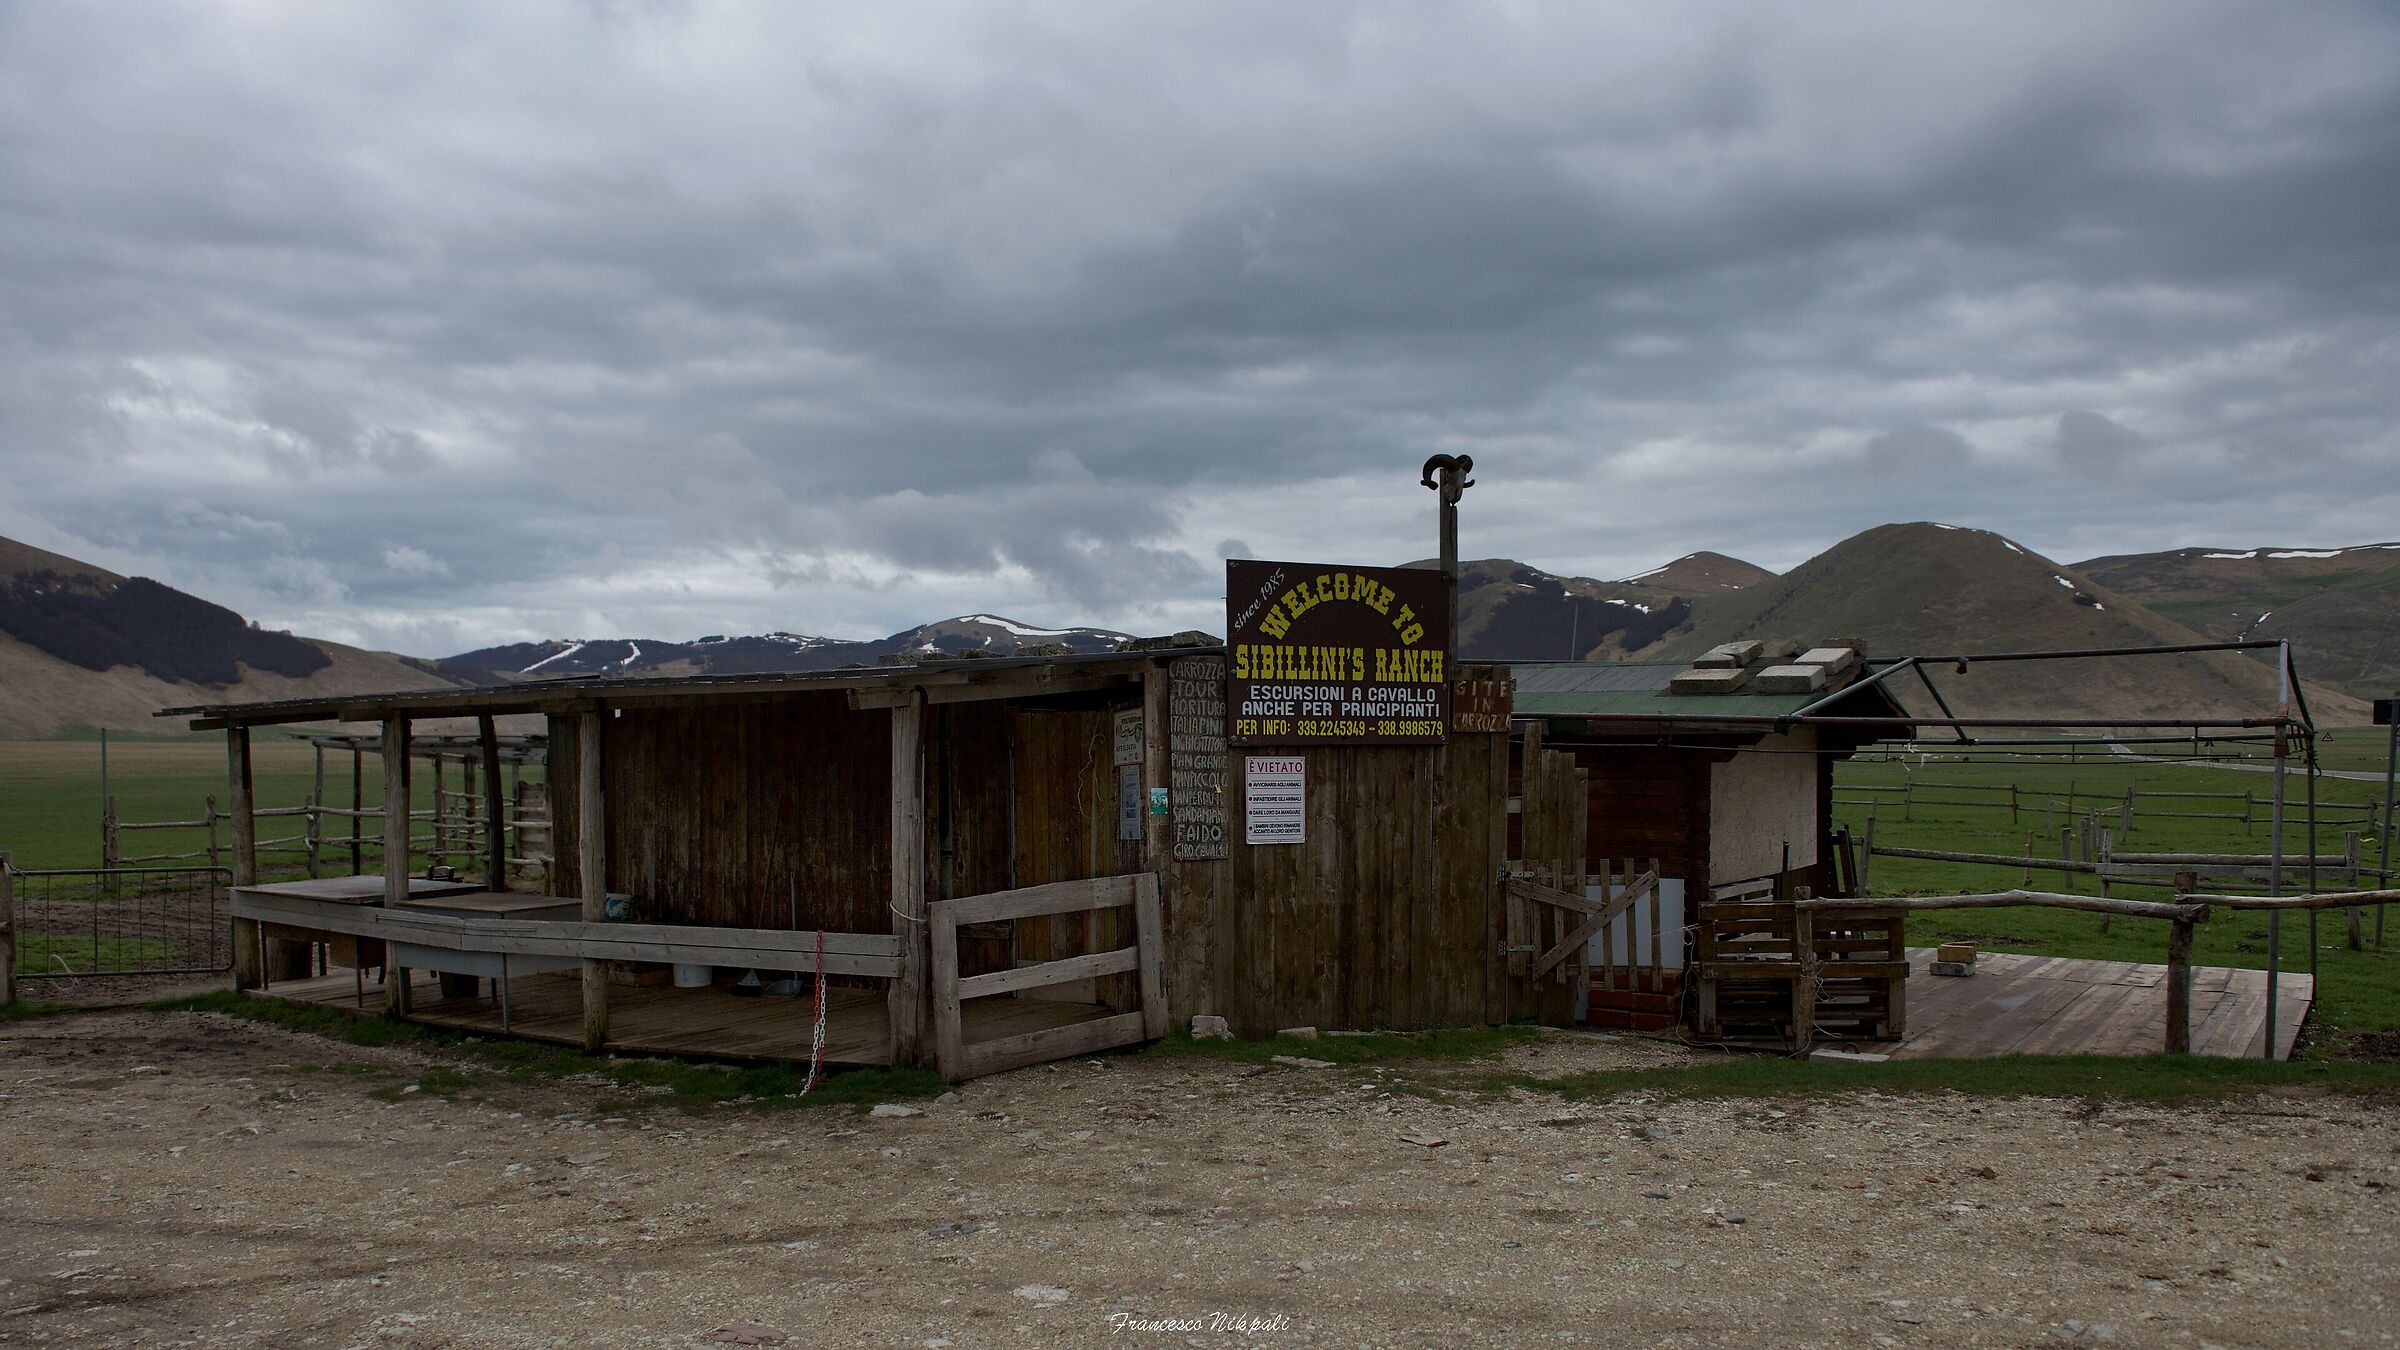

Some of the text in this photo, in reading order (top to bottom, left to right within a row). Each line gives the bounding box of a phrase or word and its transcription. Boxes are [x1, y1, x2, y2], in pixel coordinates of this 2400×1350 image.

[1234, 567, 1286, 632] since 1985
[1259, 572, 1424, 646] WELCOME TO
[1169, 661, 1226, 680] CARROZZA
[1235, 644, 1444, 683] SIBILLINI'S RANCH
[1174, 679, 1217, 698] TOUR
[1250, 685, 1436, 702] ESCURSIONI A CAVALLO
[1456, 680, 1509, 698] GITE
[1169, 693, 1226, 716] FIORITURA
[1242, 702, 1440, 718] ANCHE PER PRINCIPIANTI
[1473, 697, 1491, 713] IN
[1236, 719, 1258, 736] PER
[1263, 720, 1291, 736] INFO:
[1297, 720, 1365, 736] 339.2245349
[1377, 720, 1444, 737] 338.9986579
[1249, 759, 1303, 773] È VIETATO
[1176, 824, 1222, 842] FAIDO
[1173, 843, 1194, 859] GIRO
